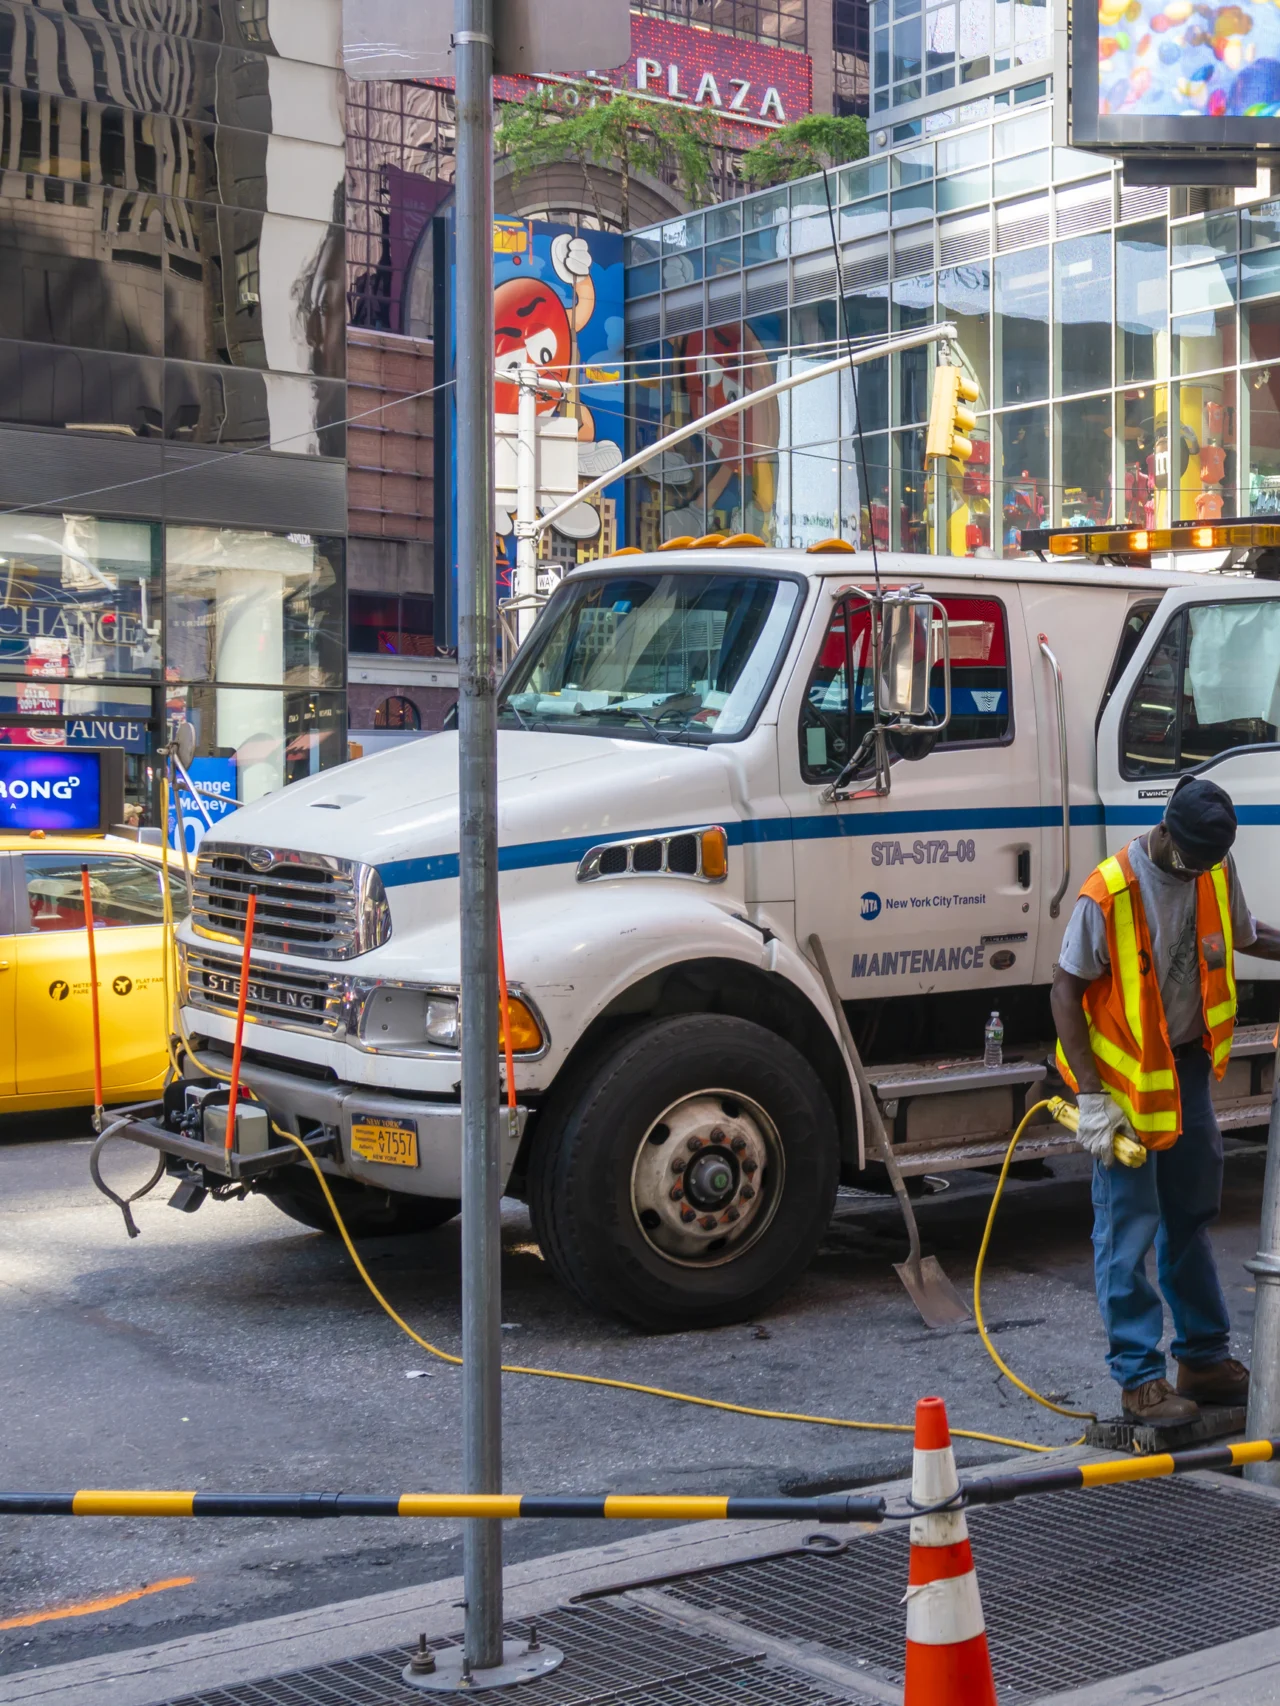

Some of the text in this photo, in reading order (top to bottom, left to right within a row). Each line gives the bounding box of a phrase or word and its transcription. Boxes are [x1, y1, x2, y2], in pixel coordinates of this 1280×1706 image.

[636, 57, 786, 121] PLAZA
[539, 577, 555, 588] WAY
[180, 798, 228, 814] Money
[871, 839, 976, 866] STA-S172-08
[860, 898, 878, 915] MTA
[886, 894, 986, 909] New York City Transit
[851, 945, 986, 978] MAINTENANCE
[208, 975, 314, 1009] STERLING
[366, 1118, 399, 1128] NEW YORK
[385, 1131, 412, 1156] 7557
